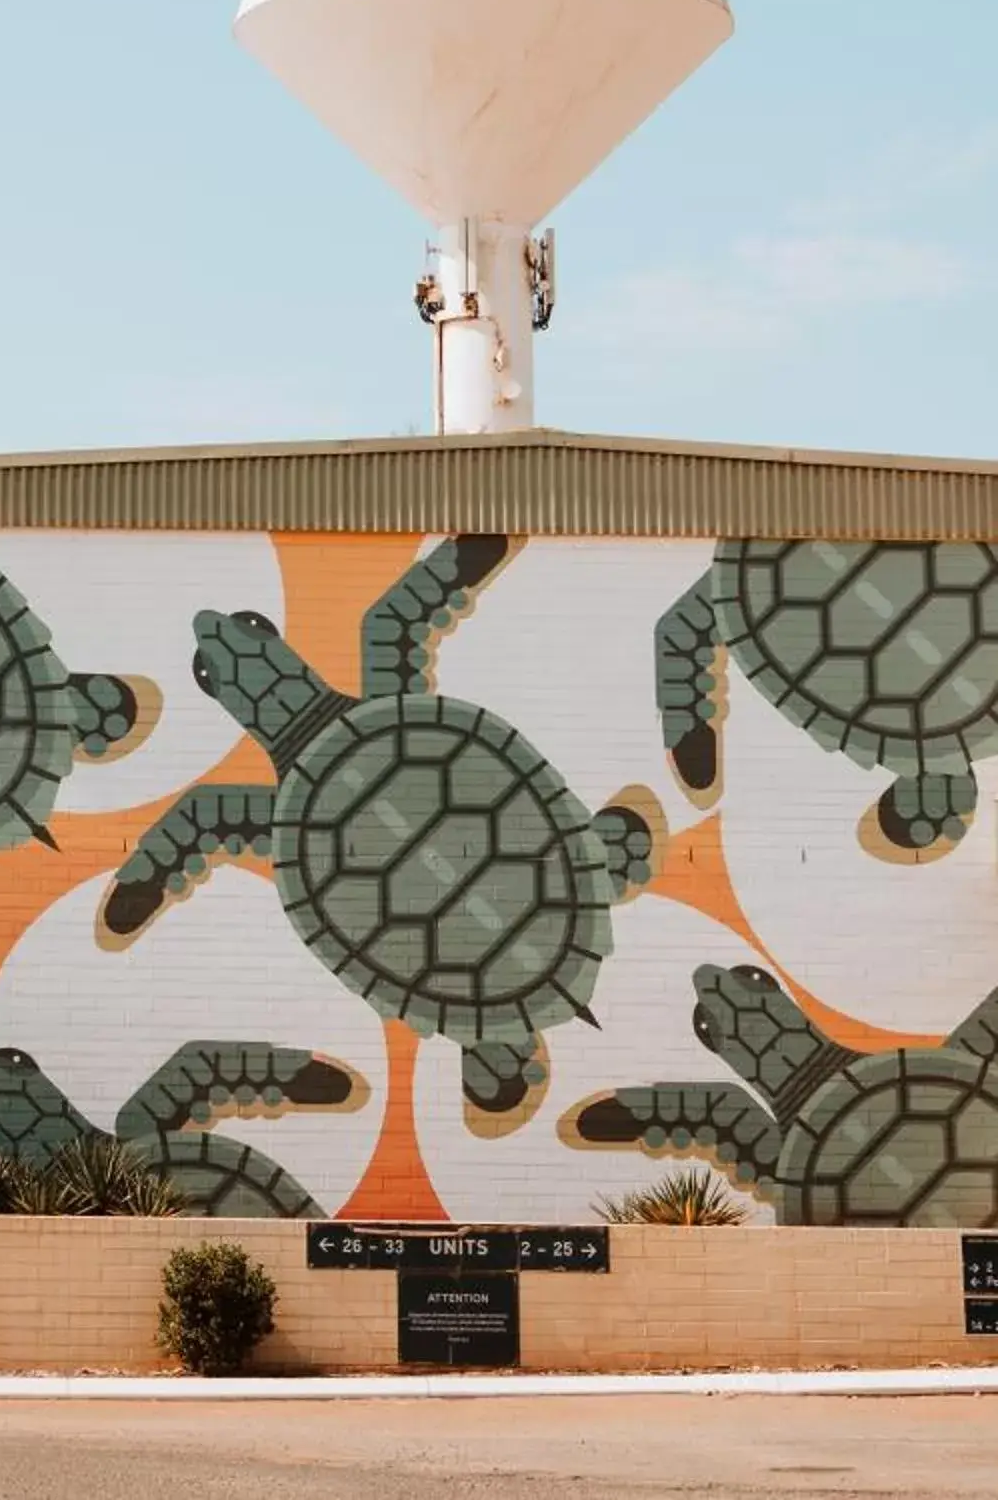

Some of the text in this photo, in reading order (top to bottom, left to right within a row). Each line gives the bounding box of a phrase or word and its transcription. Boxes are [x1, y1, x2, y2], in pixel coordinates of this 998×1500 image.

[342, 1239, 363, 1253] 26
[385, 1239, 405, 1255] 33
[429, 1238, 489, 1255] UNITS
[521, 1241, 531, 1256] 2
[553, 1241, 573, 1257] 25
[427, 1293, 489, 1303] ATTENTION
